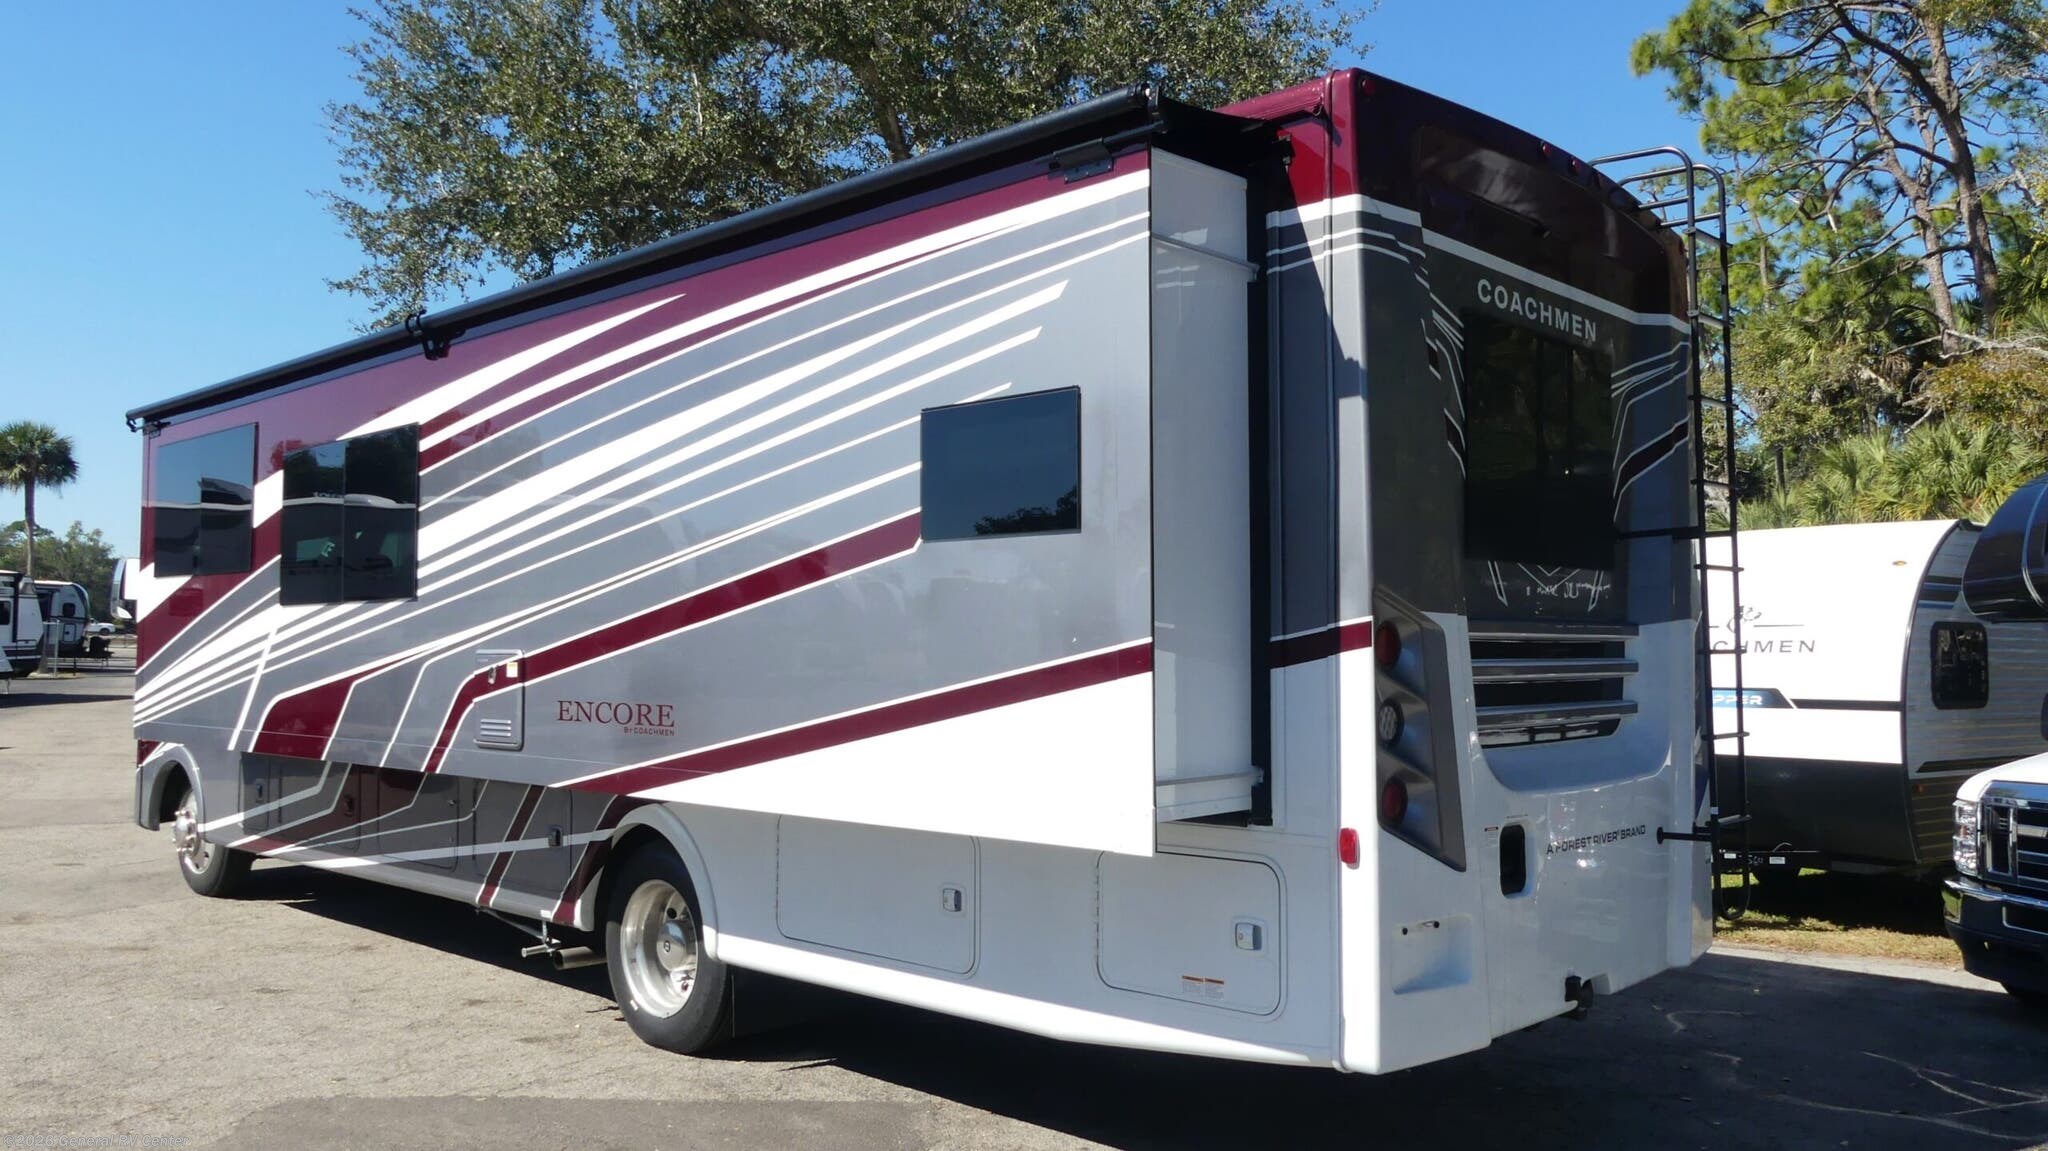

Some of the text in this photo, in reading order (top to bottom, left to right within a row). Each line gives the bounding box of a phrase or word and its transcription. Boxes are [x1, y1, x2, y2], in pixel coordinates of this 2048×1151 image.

[1477, 278, 1596, 342] COACHMEN
[1712, 640, 1815, 653] CHMEN
[1712, 694, 1763, 705] PPER
[558, 700, 675, 727] ENCORE
[633, 727, 675, 736] COACHMEN
[1546, 843, 1554, 855] A
[1555, 836, 1592, 853] FOREST
[1620, 824, 1646, 840] BRAND
